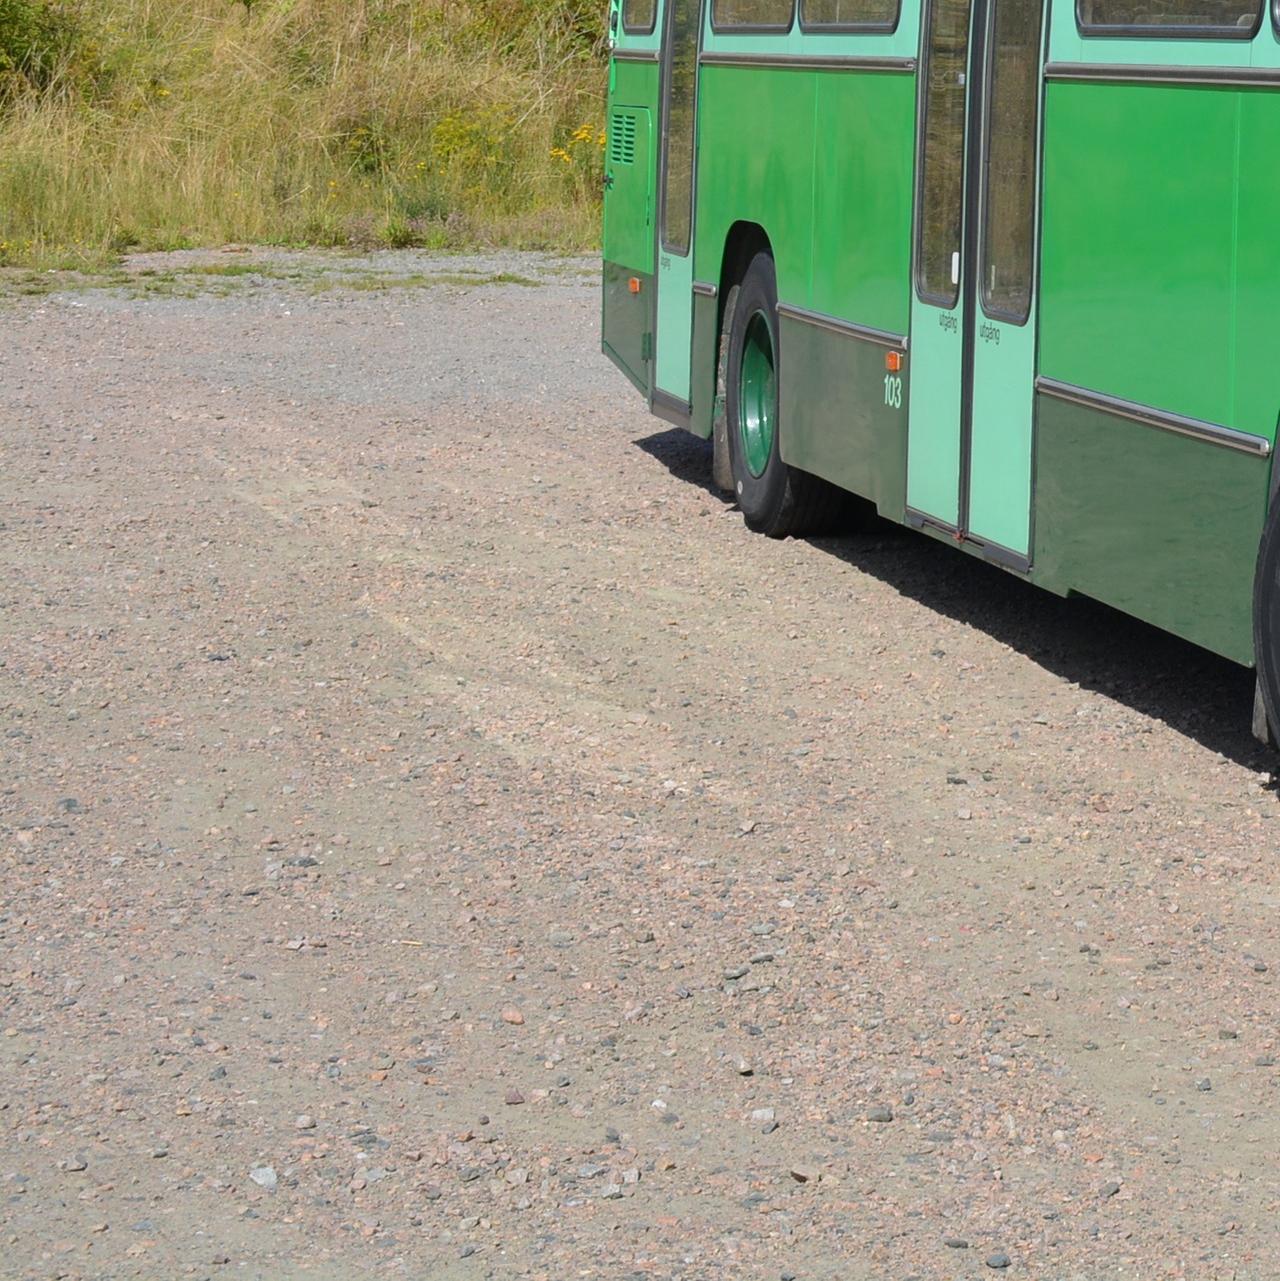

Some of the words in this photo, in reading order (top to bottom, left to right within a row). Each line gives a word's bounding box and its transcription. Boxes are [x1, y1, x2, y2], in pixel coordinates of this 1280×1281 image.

[939, 311, 958, 334] utgång
[980, 321, 1000, 345] utgång
[883, 373, 902, 409] 103
